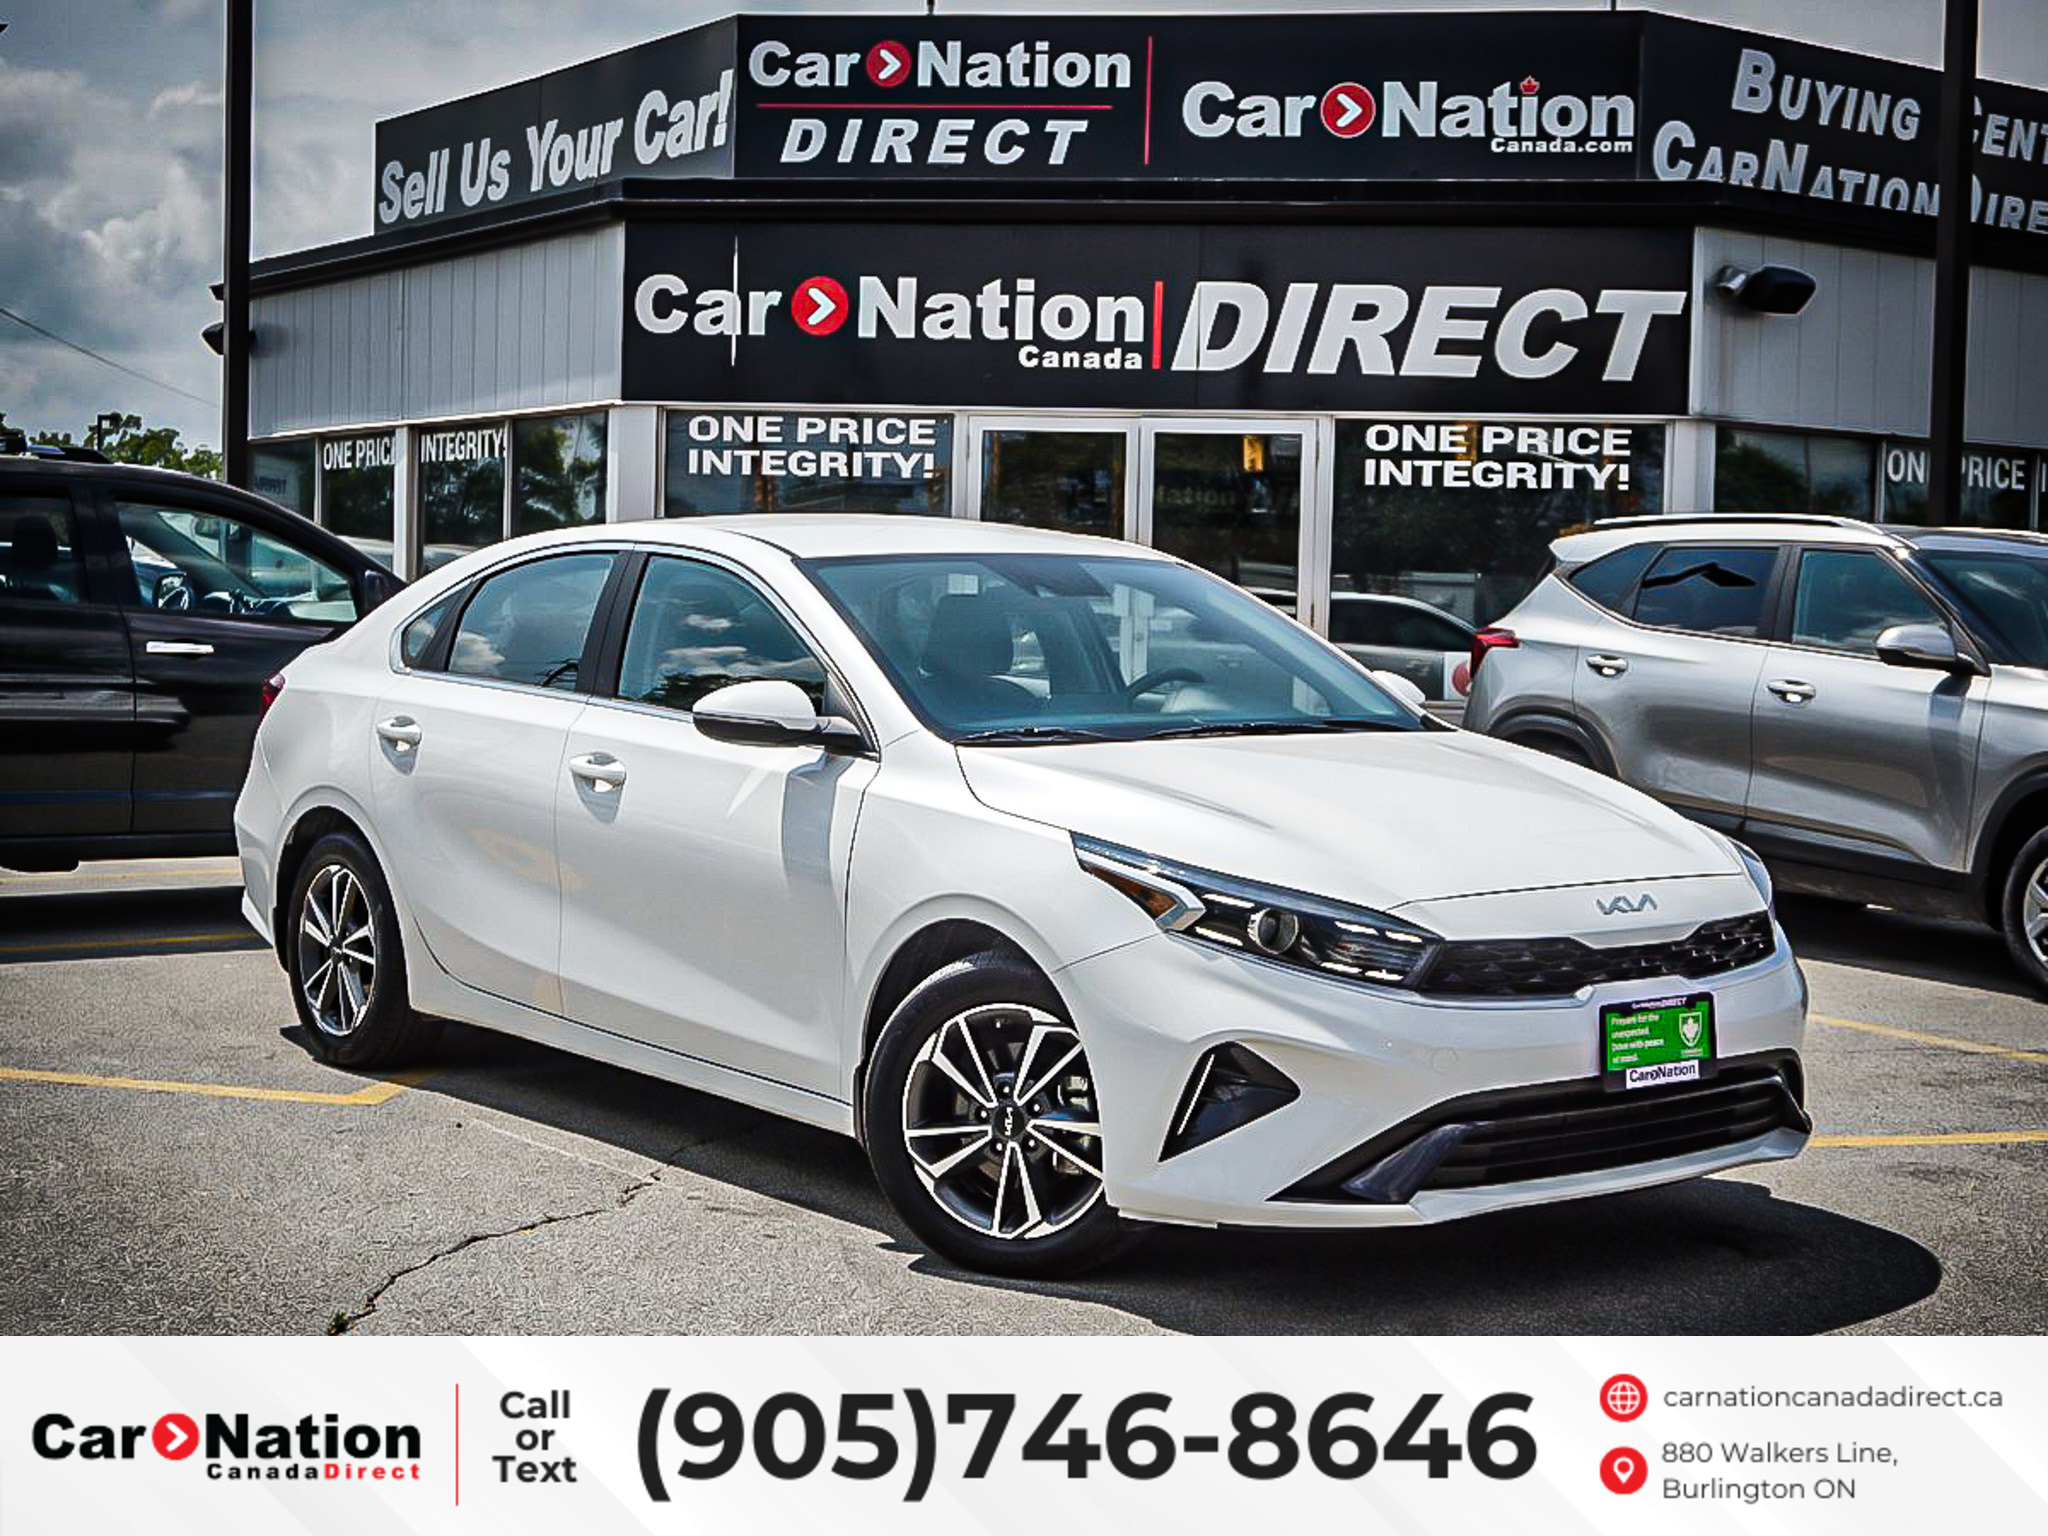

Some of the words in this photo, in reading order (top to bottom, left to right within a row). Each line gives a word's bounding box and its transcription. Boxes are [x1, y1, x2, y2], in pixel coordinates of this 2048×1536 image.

[378, 148, 449, 224] Sell
[459, 137, 510, 207] Us
[526, 114, 623, 196] Your
[634, 69, 734, 167] Car!
[780, 119, 1088, 164] DIRECT
[1491, 137, 1633, 153] Canada.com
[1171, 281, 1687, 381] DIRECT
[1019, 345, 1142, 370] Canada
[689, 416, 783, 443] ONE
[797, 416, 937, 445] PRICE
[1366, 424, 1468, 453] ONE
[1482, 427, 1632, 457] PRICE
[323, 441, 353, 471] ONE
[688, 449, 934, 478] INTEGRITY!
[1365, 458, 1629, 490] INTEGRITY!
